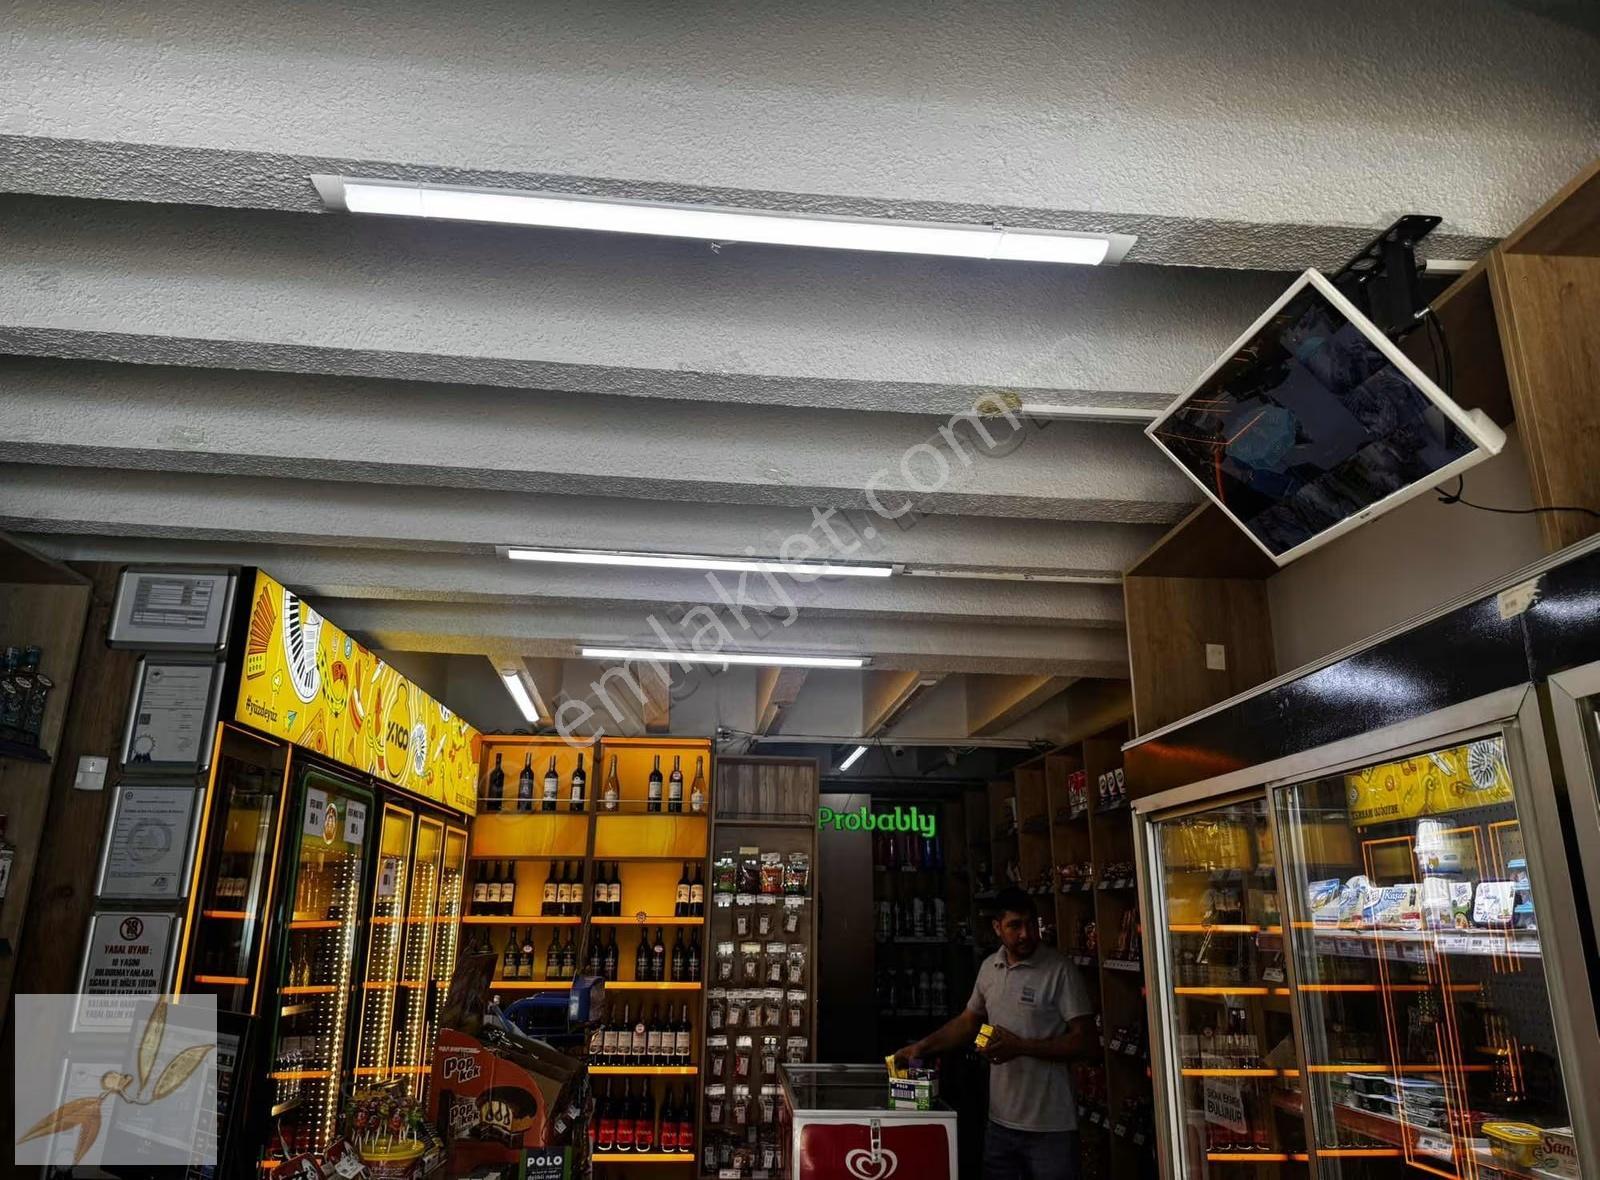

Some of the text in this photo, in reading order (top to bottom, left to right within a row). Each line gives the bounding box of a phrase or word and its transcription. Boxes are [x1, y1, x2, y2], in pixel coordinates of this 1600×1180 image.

[246, 695, 278, 723] #yüzdeyüz
[817, 805, 937, 838] Probably
[104, 944, 126, 955] YASAL
[527, 1155, 563, 1168] POLO
